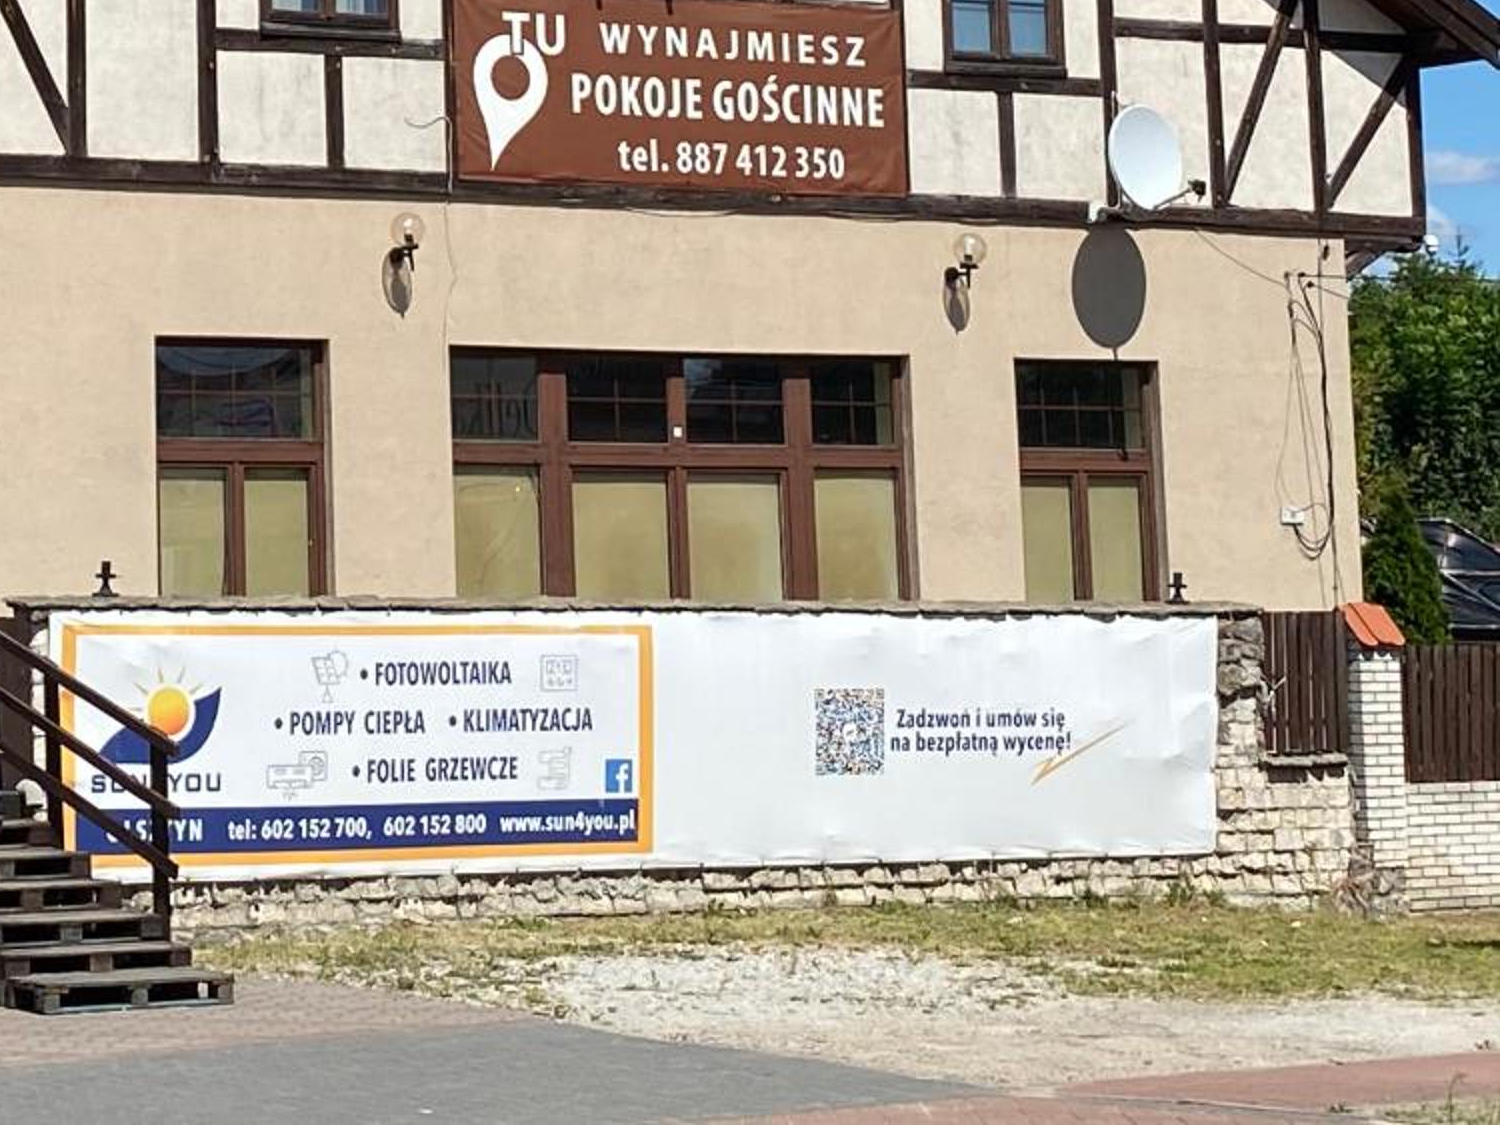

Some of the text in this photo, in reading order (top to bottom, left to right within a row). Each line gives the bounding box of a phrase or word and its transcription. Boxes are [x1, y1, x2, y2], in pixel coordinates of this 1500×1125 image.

[502, 11, 866, 67] TU WYNAJMIESZ
[571, 73, 885, 128] POKOJE GOŚCINNE
[618, 139, 845, 179] tel. 887 412 350
[374, 660, 513, 687] FOTOWOLTAIKA
[289, 706, 593, 736] POMPY CIEPŁA KLIMATYZACJA
[896, 708, 1066, 731] Zadzwoń i umów się
[891, 731, 1072, 756] na bezpłatną wycenę!
[367, 756, 519, 784] FOLIE GRZEWCZE
[228, 819, 257, 841] tel:
[261, 818, 295, 841] 602
[298, 817, 331, 839] 152
[334, 816, 373, 843] 700,
[383, 815, 417, 838] 602
[419, 814, 452, 837] 152
[454, 813, 487, 836] 800
[499, 810, 636, 840] www.sun4you.pl
